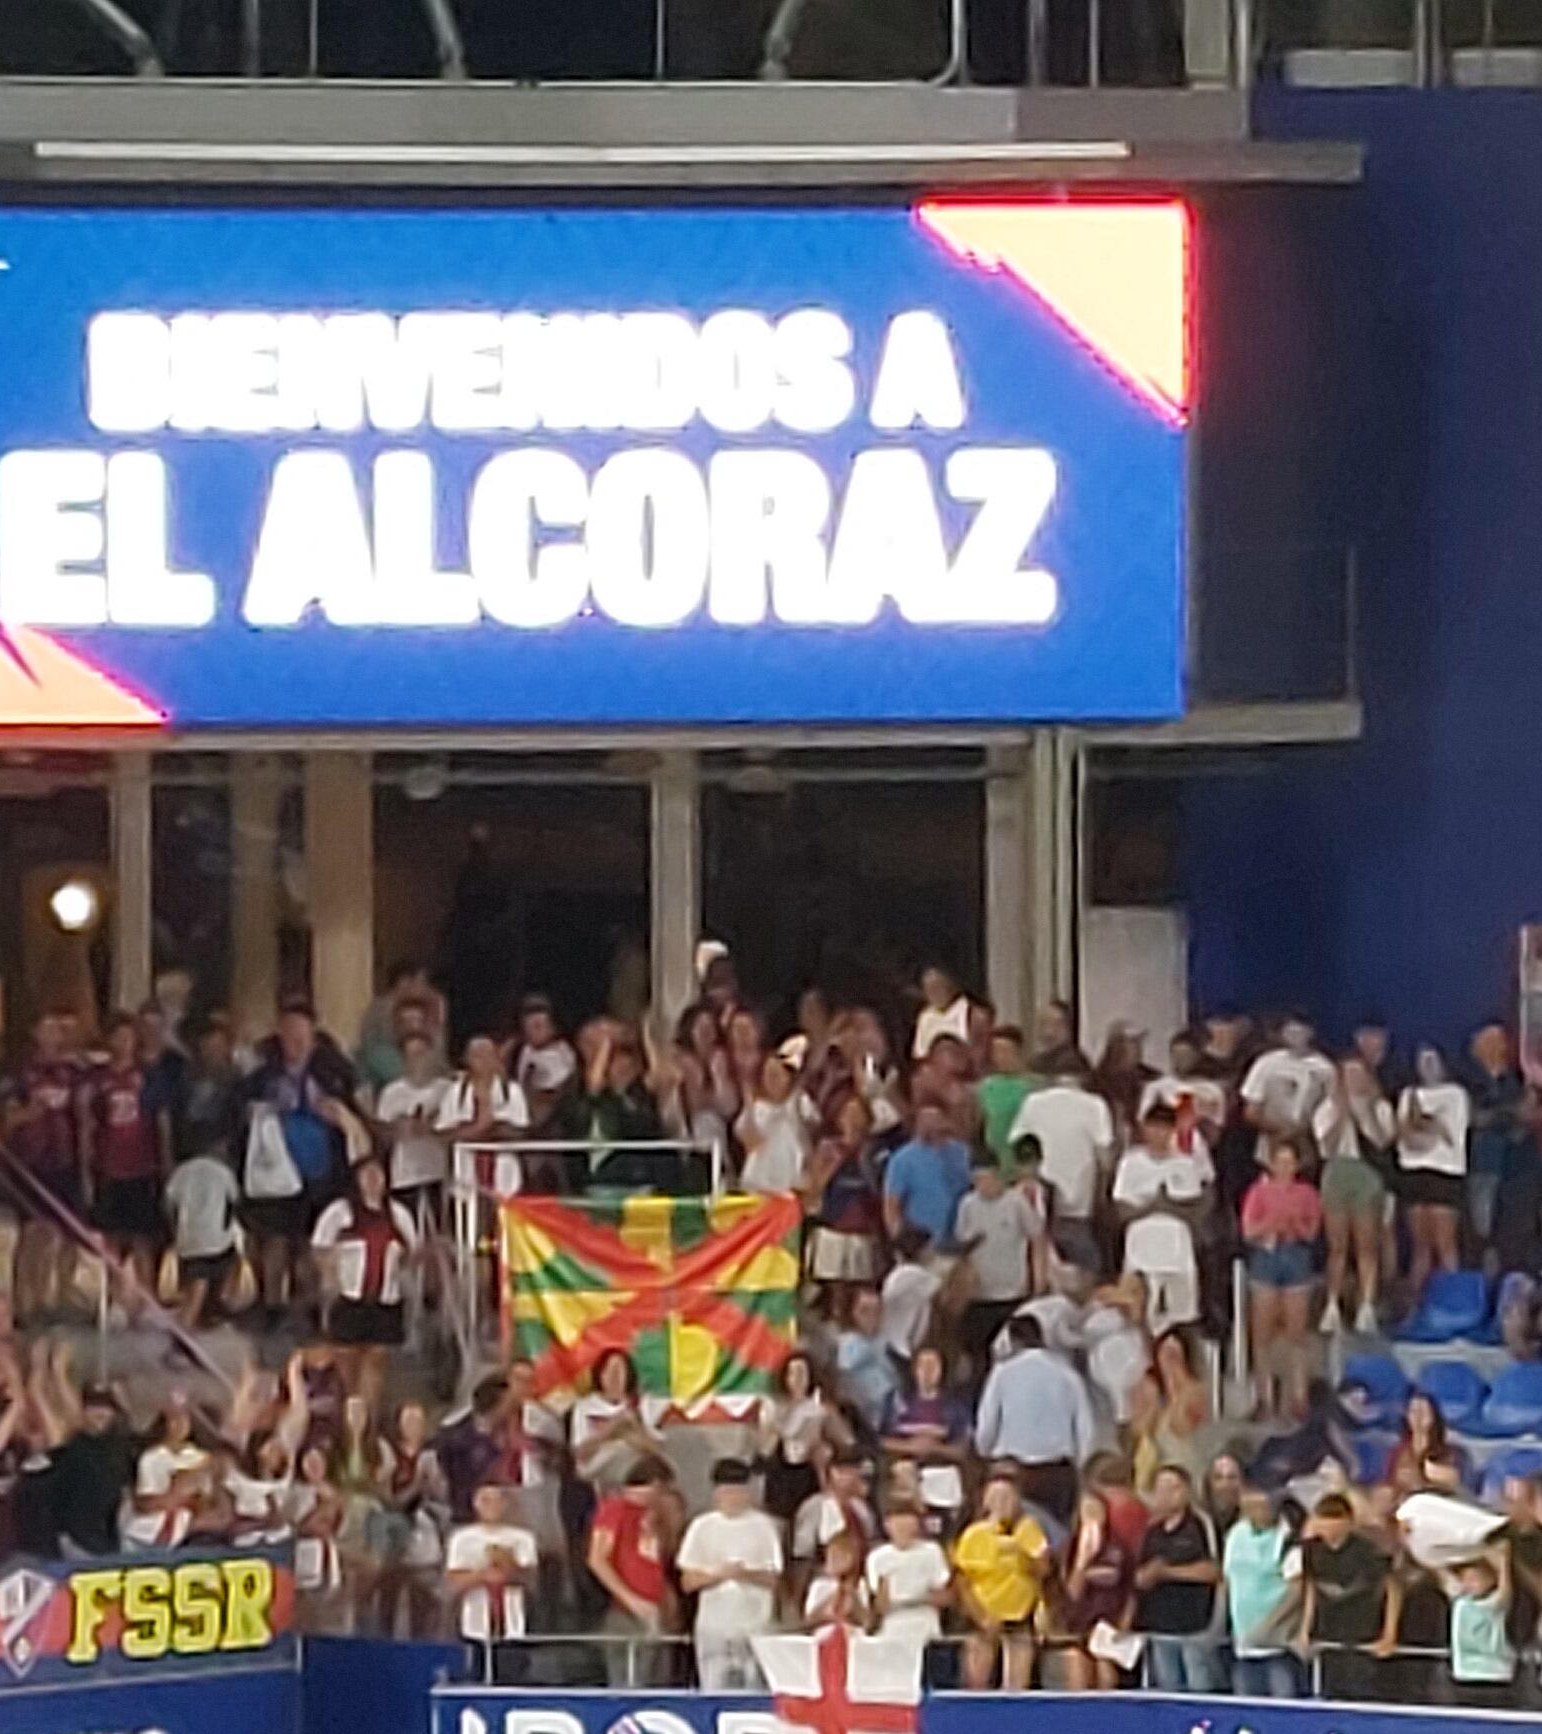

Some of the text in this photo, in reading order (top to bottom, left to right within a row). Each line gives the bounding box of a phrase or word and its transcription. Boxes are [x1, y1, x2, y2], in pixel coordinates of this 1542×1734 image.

[86, 308, 967, 434] BIENVENIDOS A
[242, 448, 1059, 628] ALCORAZ
[67, 1557, 274, 1664] FSSR
